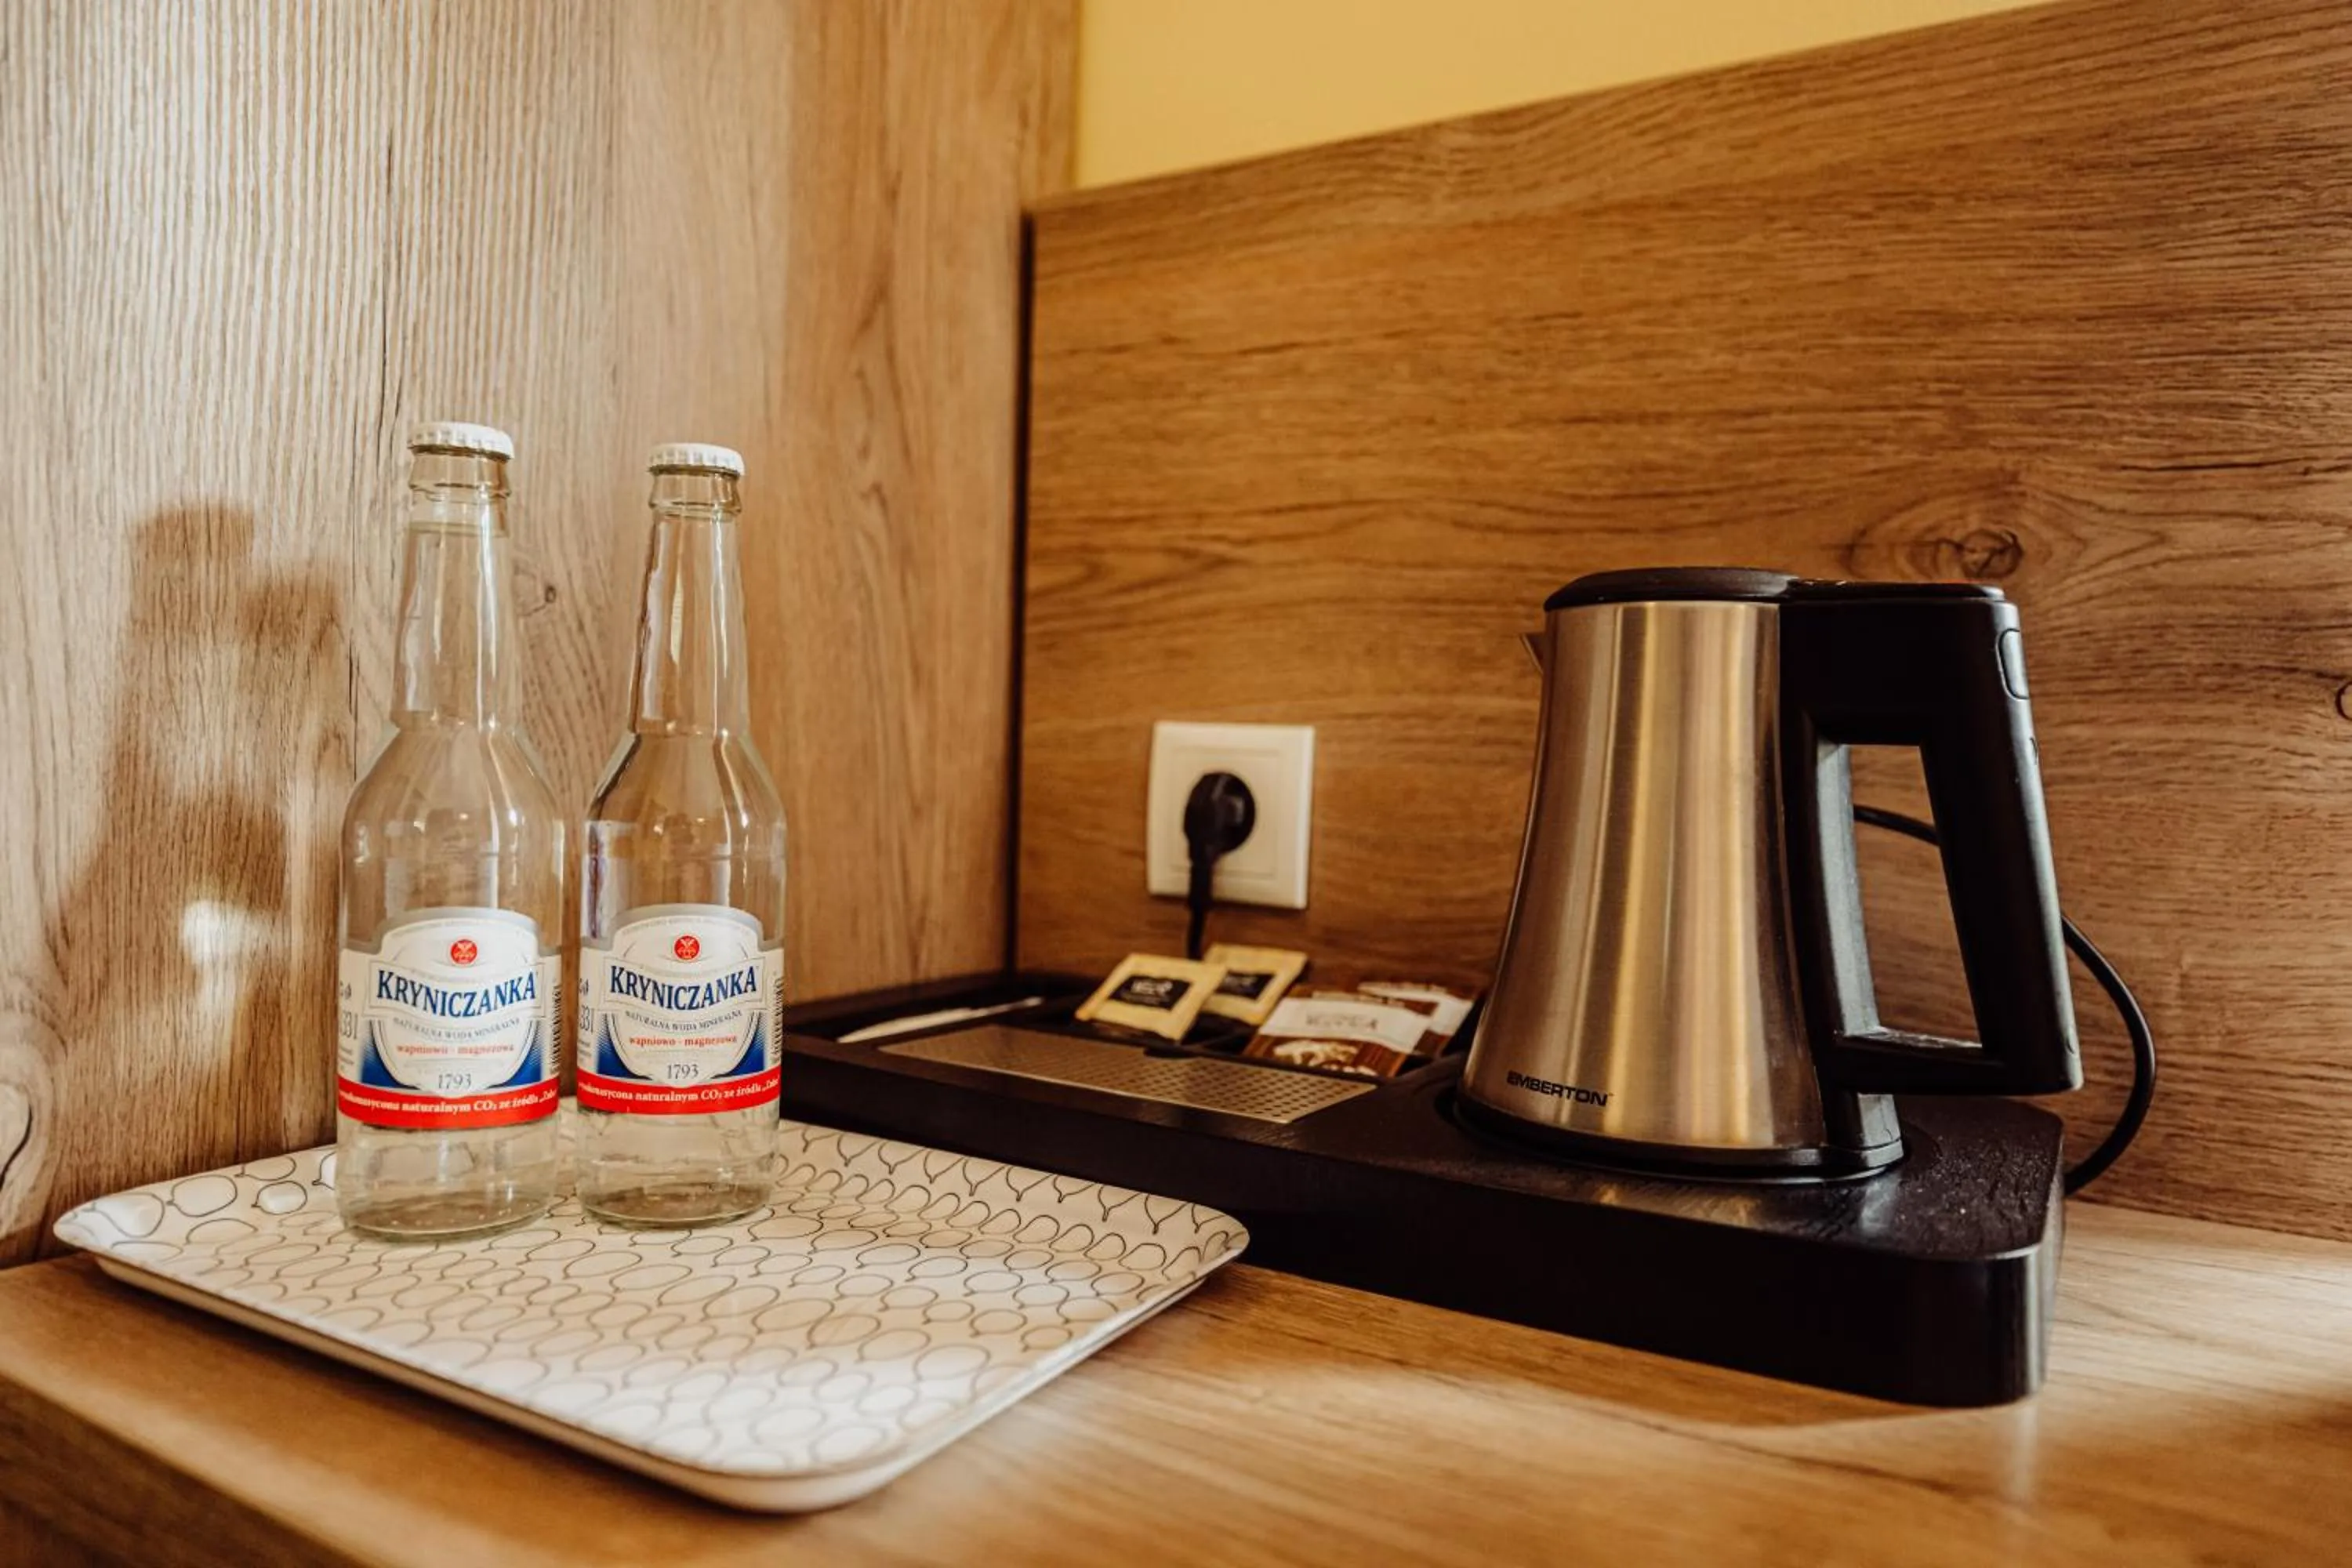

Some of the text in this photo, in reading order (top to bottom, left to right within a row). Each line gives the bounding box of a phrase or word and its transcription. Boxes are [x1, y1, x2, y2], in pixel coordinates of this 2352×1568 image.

[376, 968, 536, 1018] KRYNICZANKA
[610, 964, 757, 1011] KRYNICZANKA
[626, 1009, 742, 1031] NATURALNA WODA MINERALNA
[630, 1036, 676, 1047] wapniowo
[684, 1034, 737, 1047] magnezowa
[667, 1063, 699, 1080] 1793
[437, 1073, 472, 1090] 1793
[1506, 1069, 1607, 1108] EMBERTON
[634, 1091, 699, 1103] naturalnym
[401, 1100, 471, 1115] naturalnym
